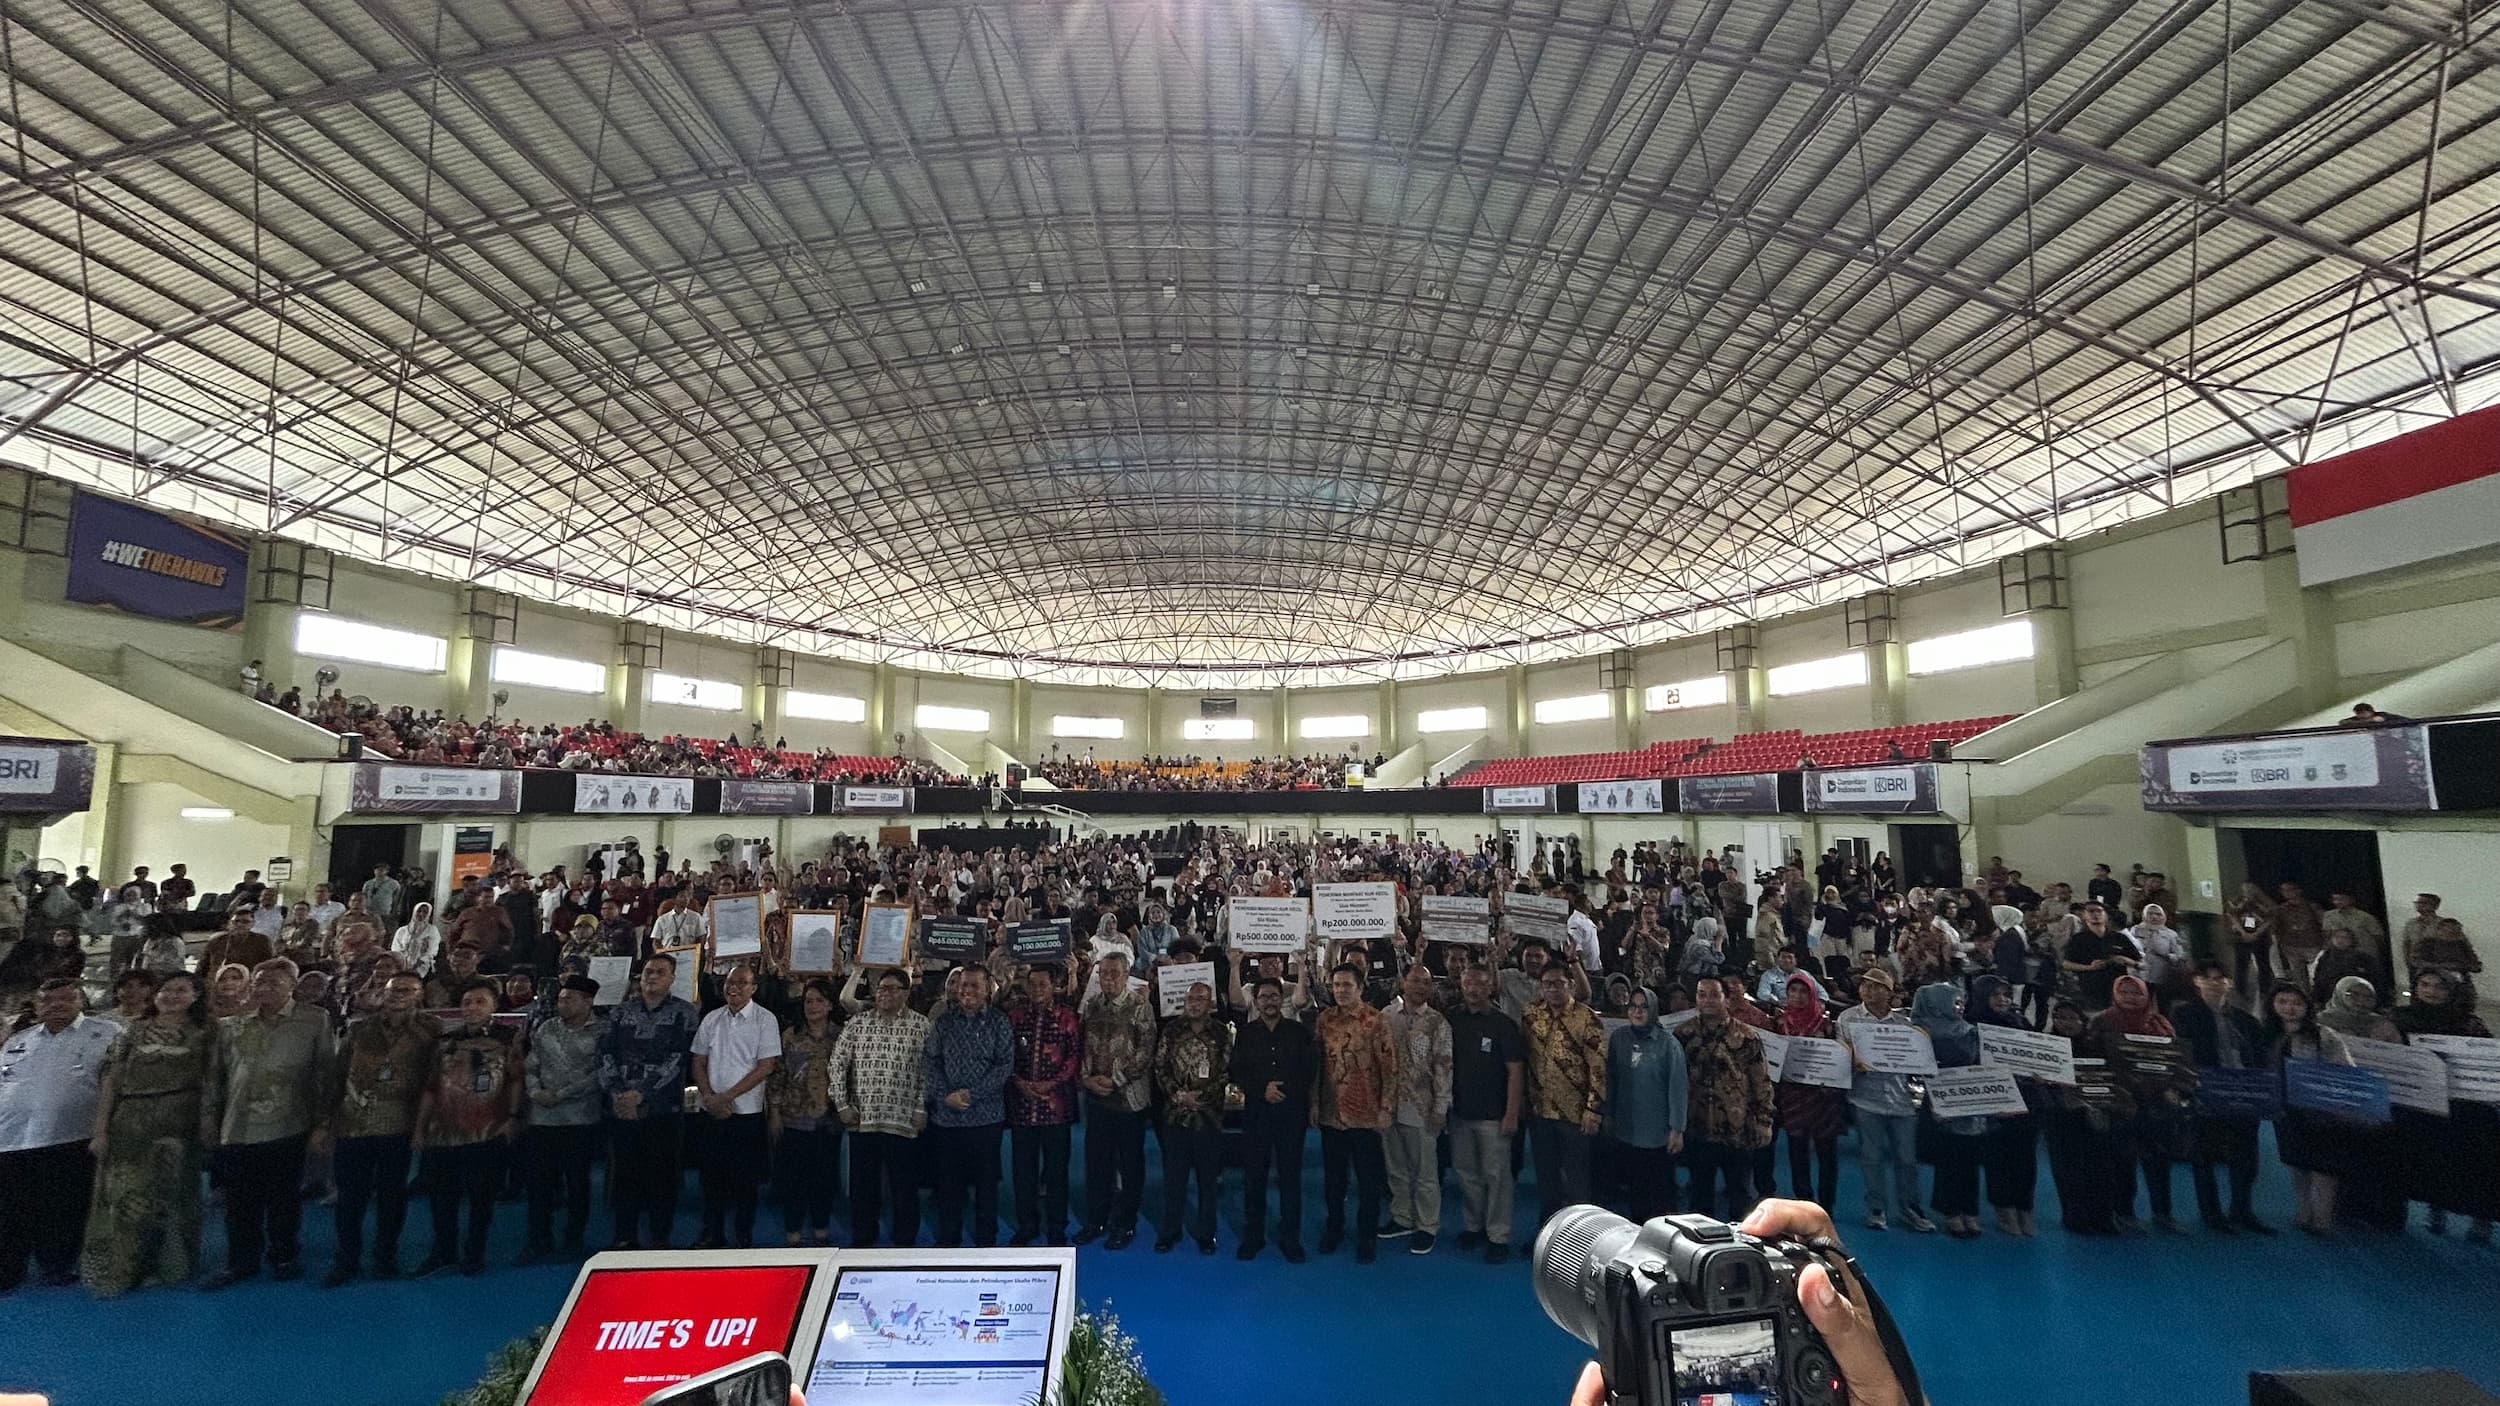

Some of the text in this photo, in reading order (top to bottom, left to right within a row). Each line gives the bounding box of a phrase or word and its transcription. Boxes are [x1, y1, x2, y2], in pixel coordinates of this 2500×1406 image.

[102, 540, 227, 587] #WETHEHAWKS
[0, 758, 40, 779] BRI
[2266, 768, 2290, 781] BRI
[1886, 777, 1907, 792] BRI
[1322, 918, 1390, 928] Rp200.000.000,-
[1236, 932, 1301, 942] Rp500.000.000,-
[1007, 1303, 1033, 1312] 1.000
[595, 1317, 758, 1350] TIME'S UP!
